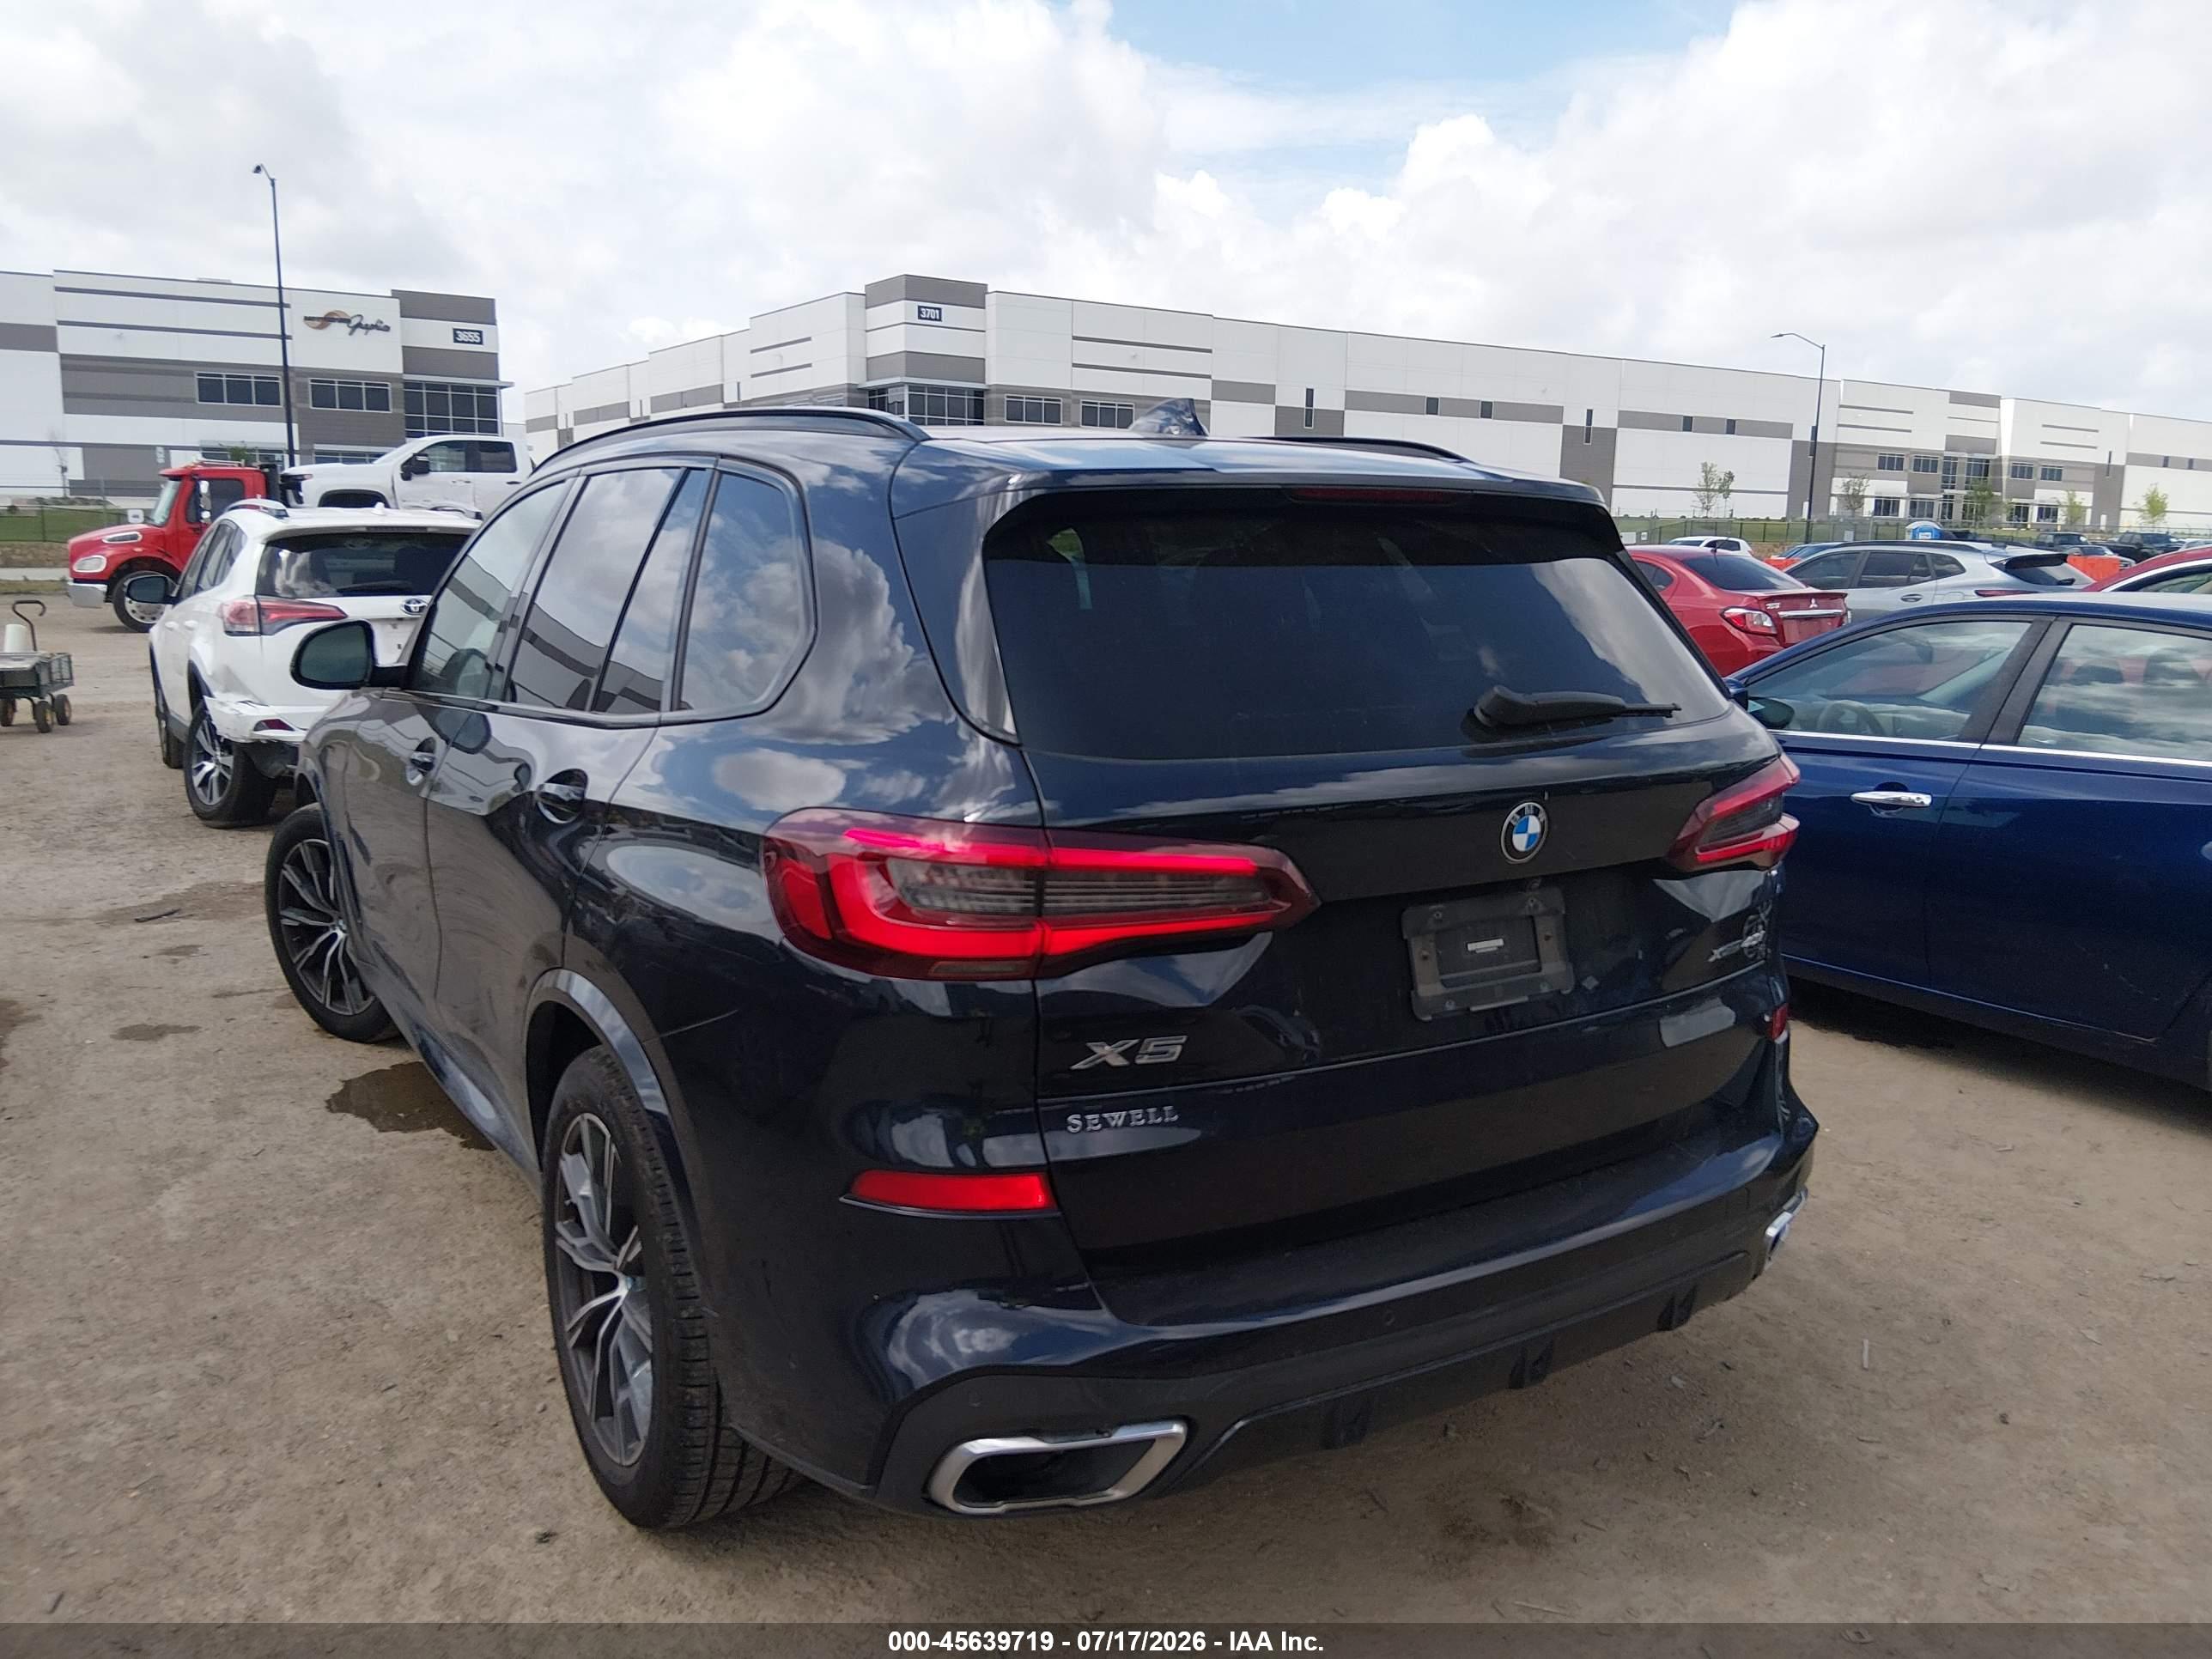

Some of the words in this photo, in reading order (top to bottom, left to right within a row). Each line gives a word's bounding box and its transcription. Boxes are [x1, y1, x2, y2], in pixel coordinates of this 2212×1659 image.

[920, 307, 940, 319] 3701
[1070, 1035, 1188, 1070] X5
[1066, 1105, 1179, 1133] SEWELL
